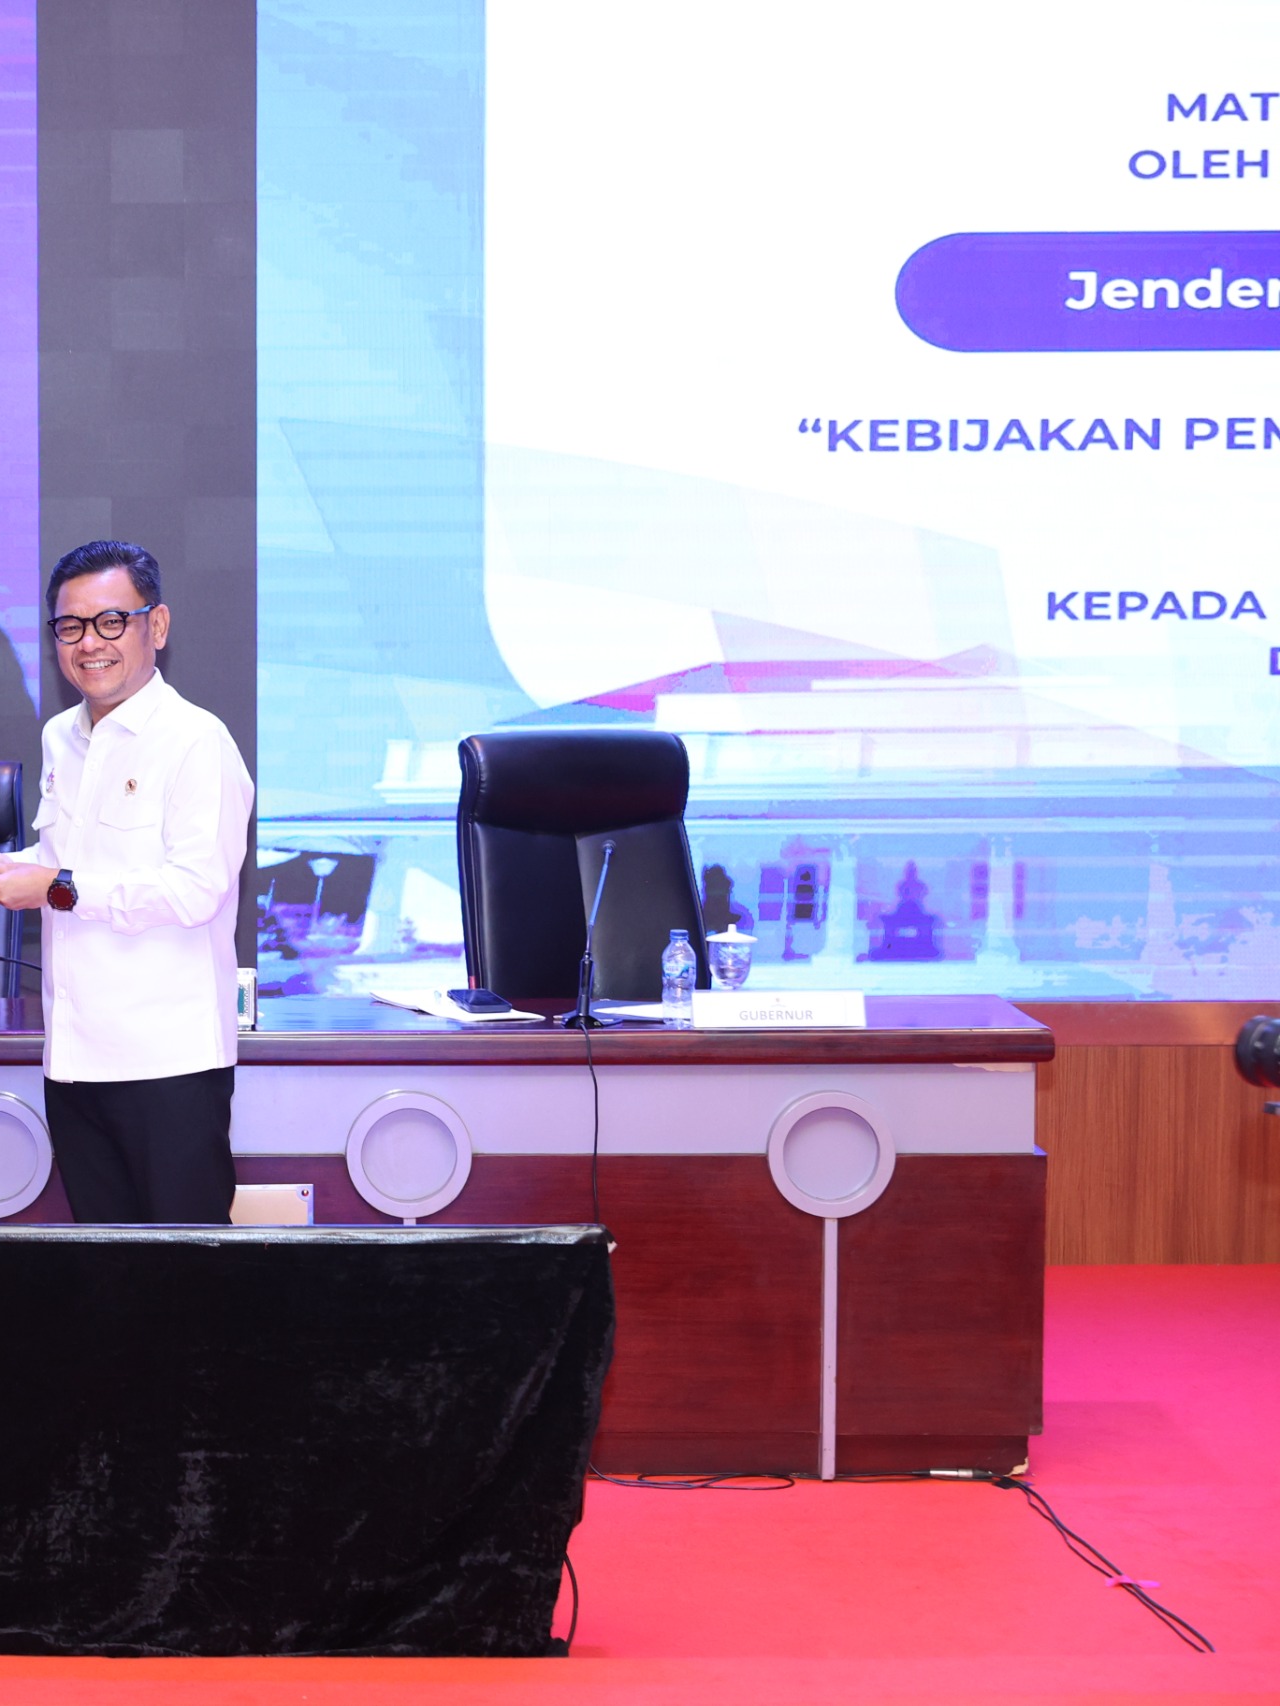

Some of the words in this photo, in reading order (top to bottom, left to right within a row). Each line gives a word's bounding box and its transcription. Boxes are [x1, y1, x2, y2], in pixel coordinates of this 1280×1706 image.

[1167, 92, 1280, 122] MAT
[1128, 149, 1269, 180] OLEH
[798, 417, 1161, 453] “KEBIJAKAN
[1047, 590, 1267, 621] KEPADA
[738, 1010, 814, 1021] GUBERNUR
